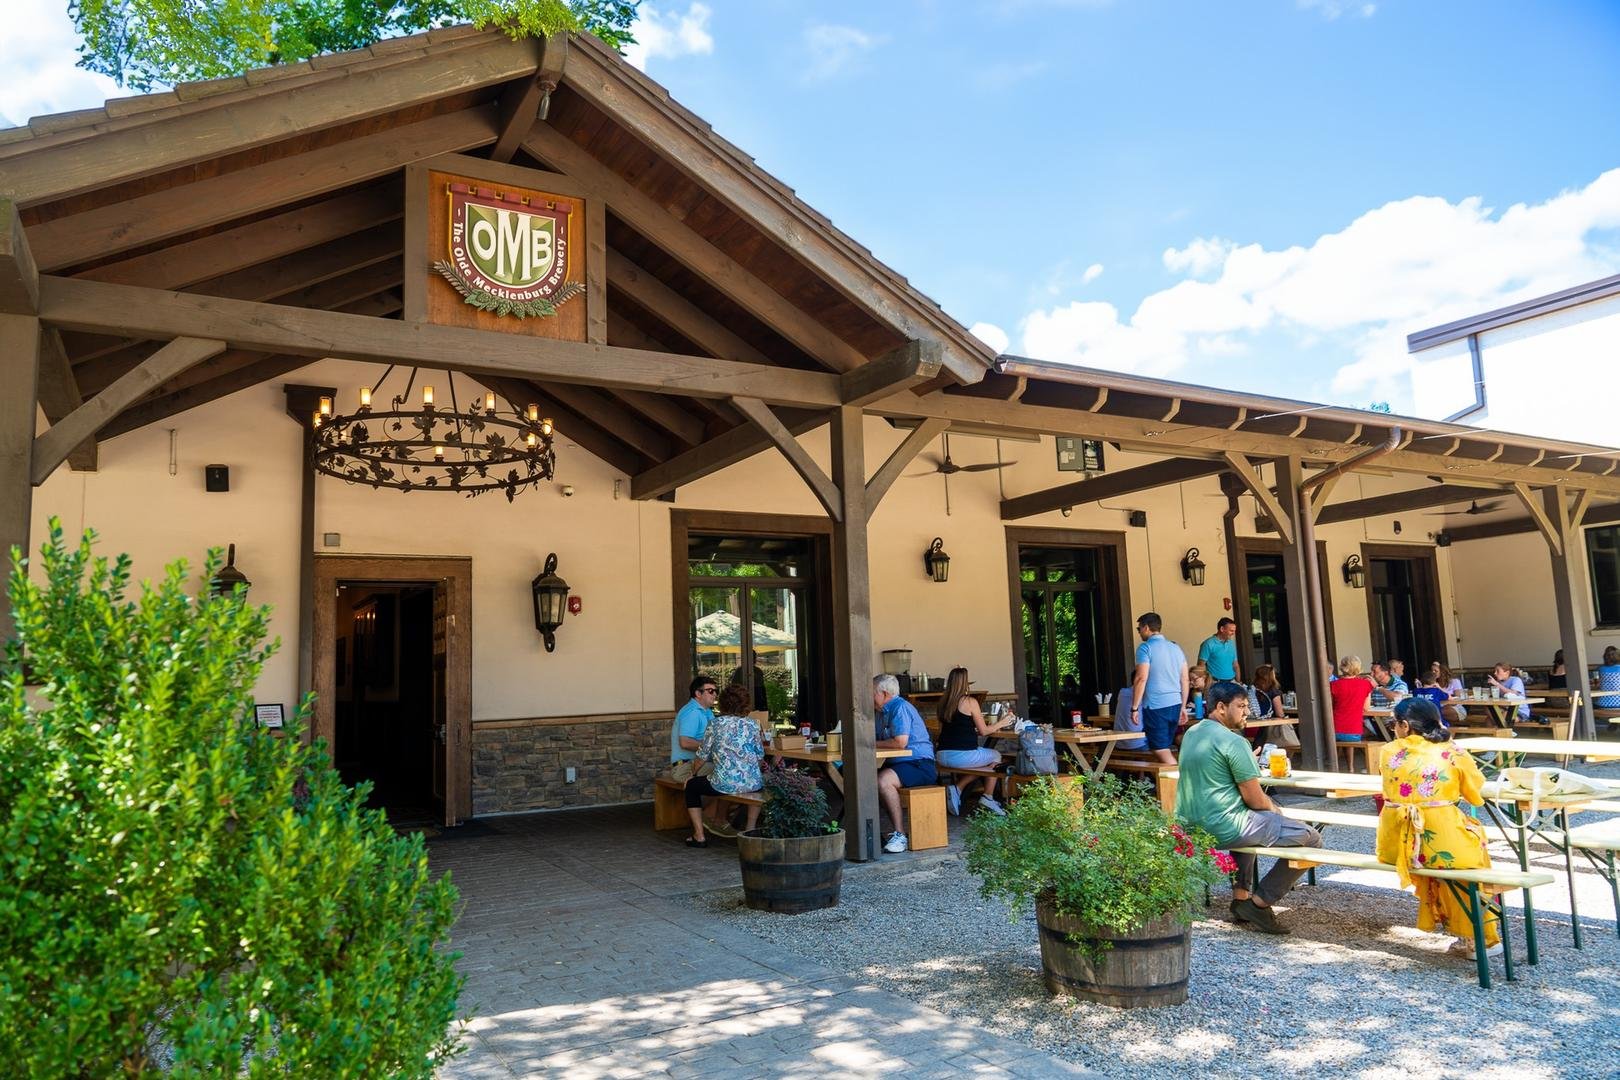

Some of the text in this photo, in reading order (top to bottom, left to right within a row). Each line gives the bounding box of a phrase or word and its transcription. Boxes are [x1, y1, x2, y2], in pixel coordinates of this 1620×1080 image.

[453, 222, 567, 300] The Olde Mecklenburg Brewery
[472, 209, 552, 281] OMB
